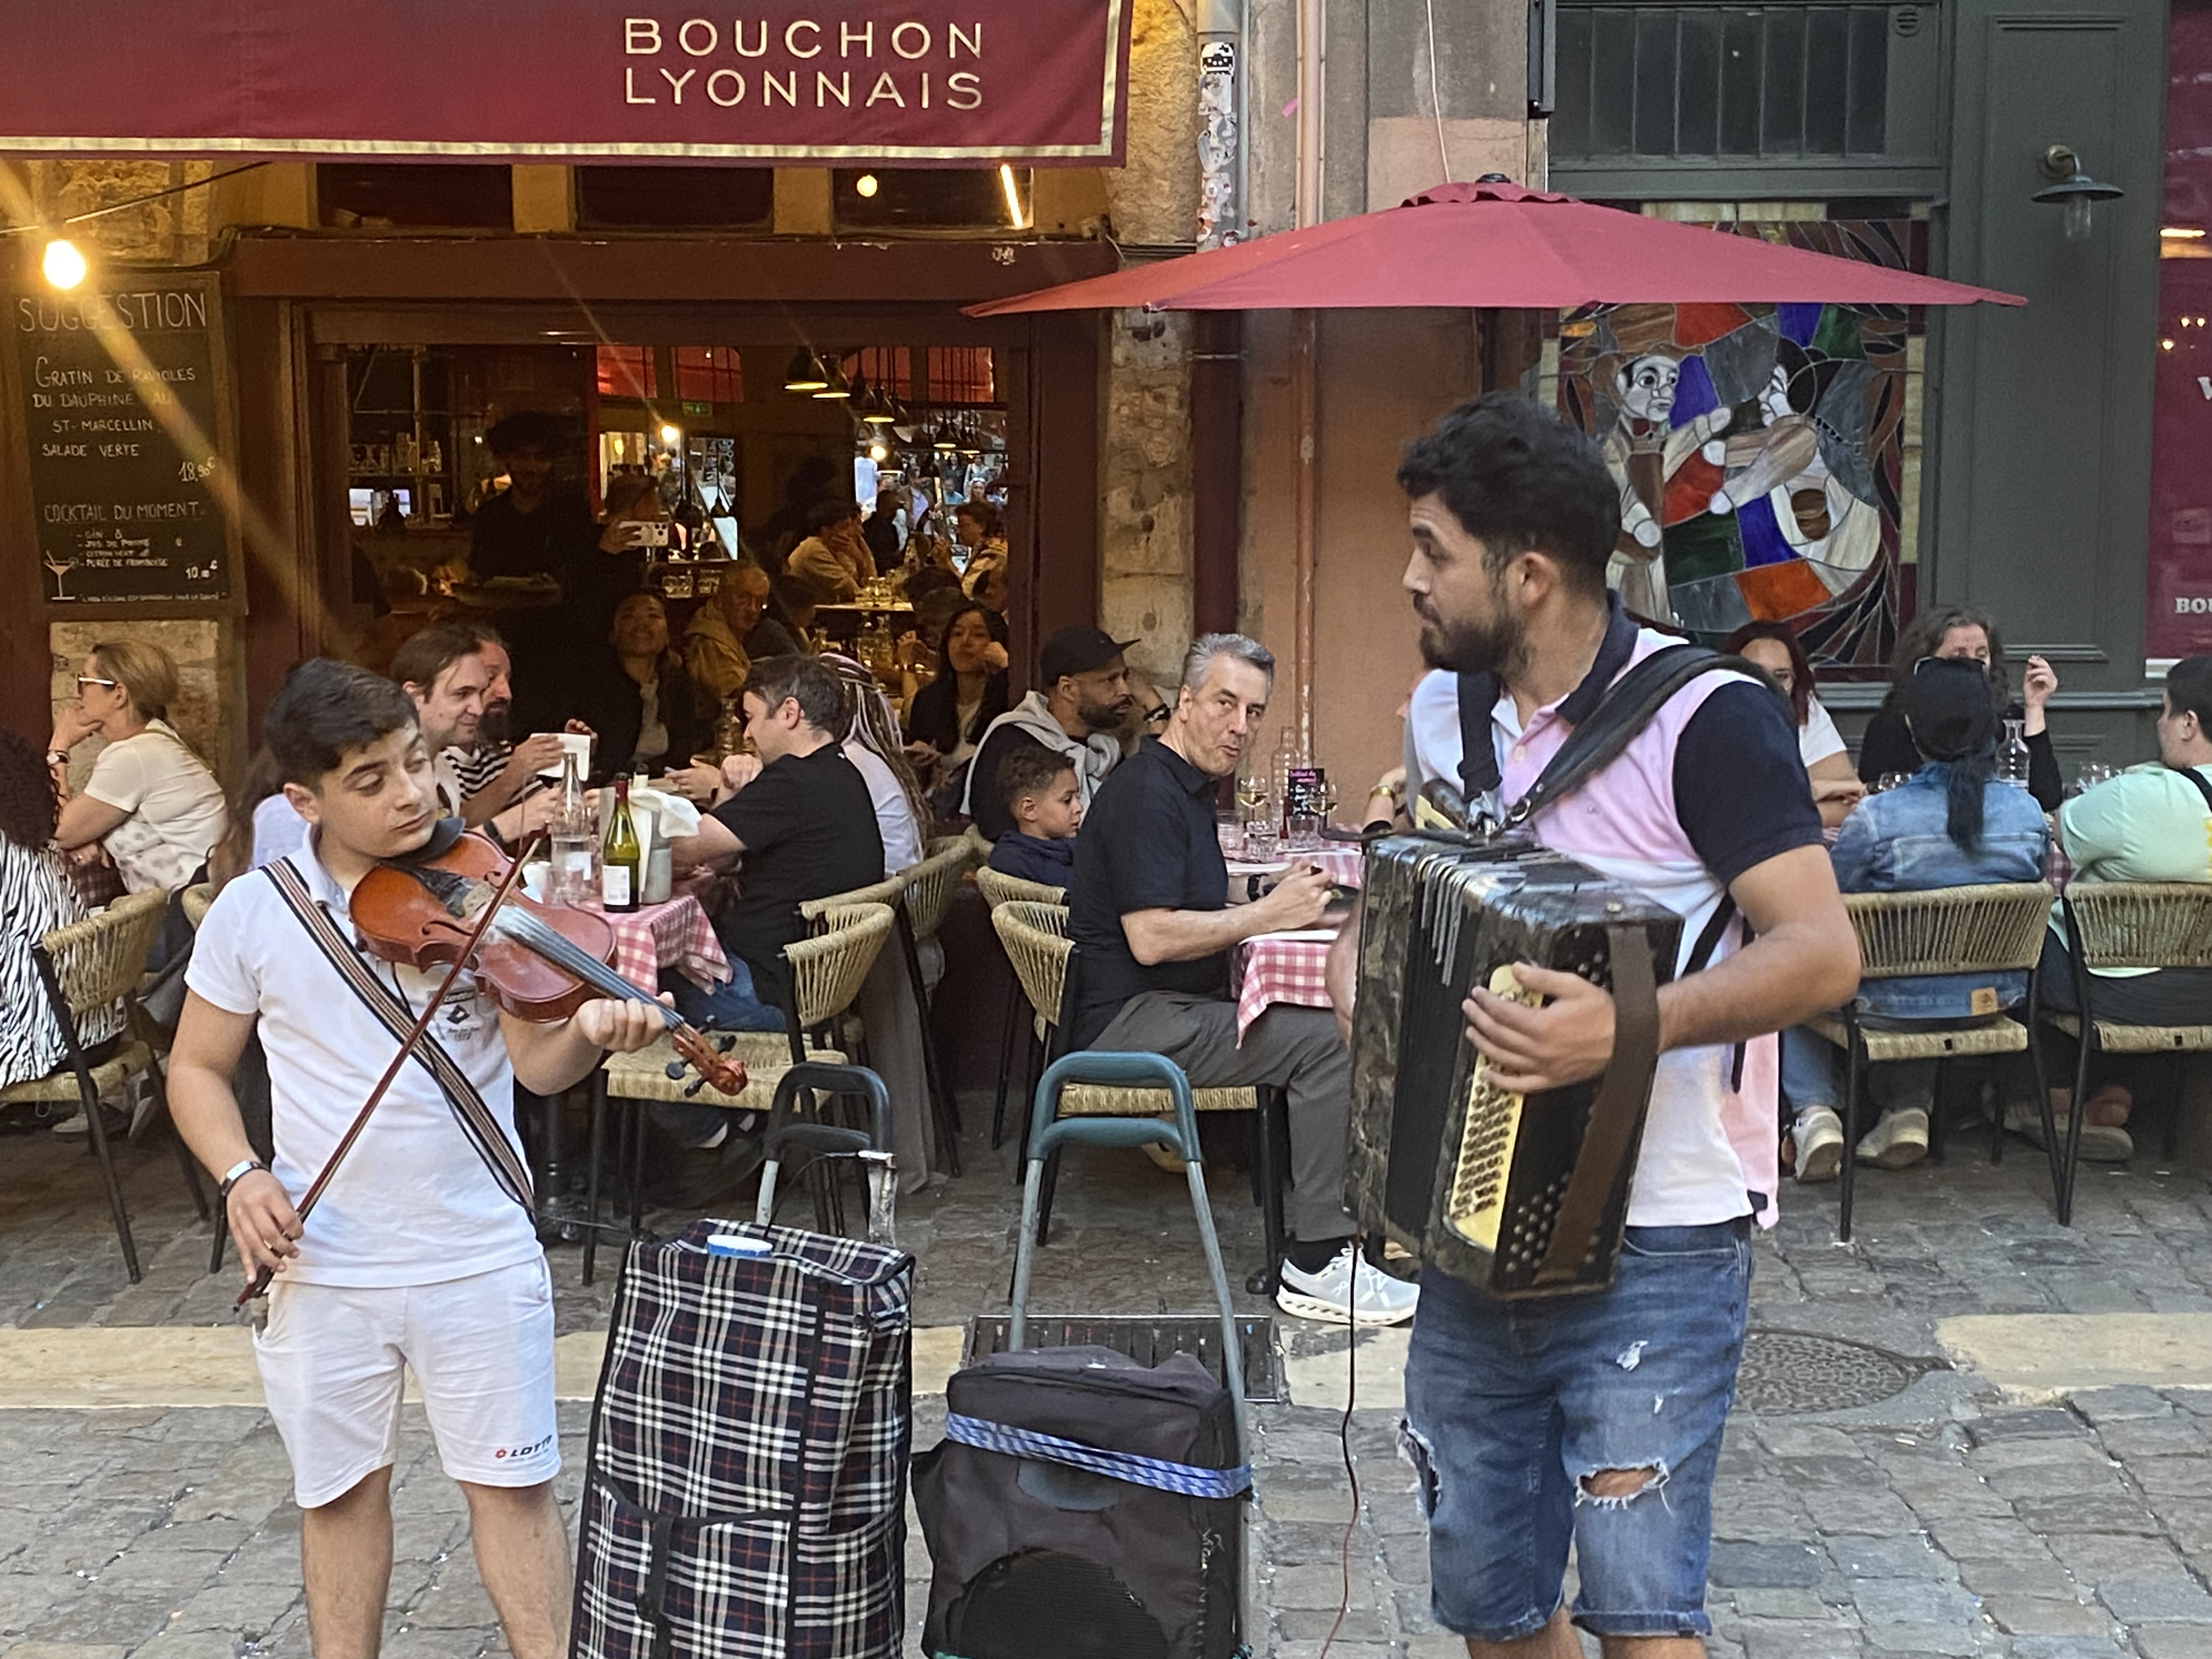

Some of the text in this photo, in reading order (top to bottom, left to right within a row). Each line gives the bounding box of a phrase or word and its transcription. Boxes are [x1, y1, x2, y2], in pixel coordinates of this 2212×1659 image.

[624, 18, 981, 59] BOUCHON
[624, 67, 982, 110] LYONNAIS
[19, 292, 206, 332] SUGGESTION
[35, 357, 195, 387] GRATIN DE RAVIOLES
[32, 393, 52, 408] DU
[42, 443, 139, 457] SALADE VERTE
[44, 504, 106, 522] COCKTAIL
[114, 505, 132, 520] DU
